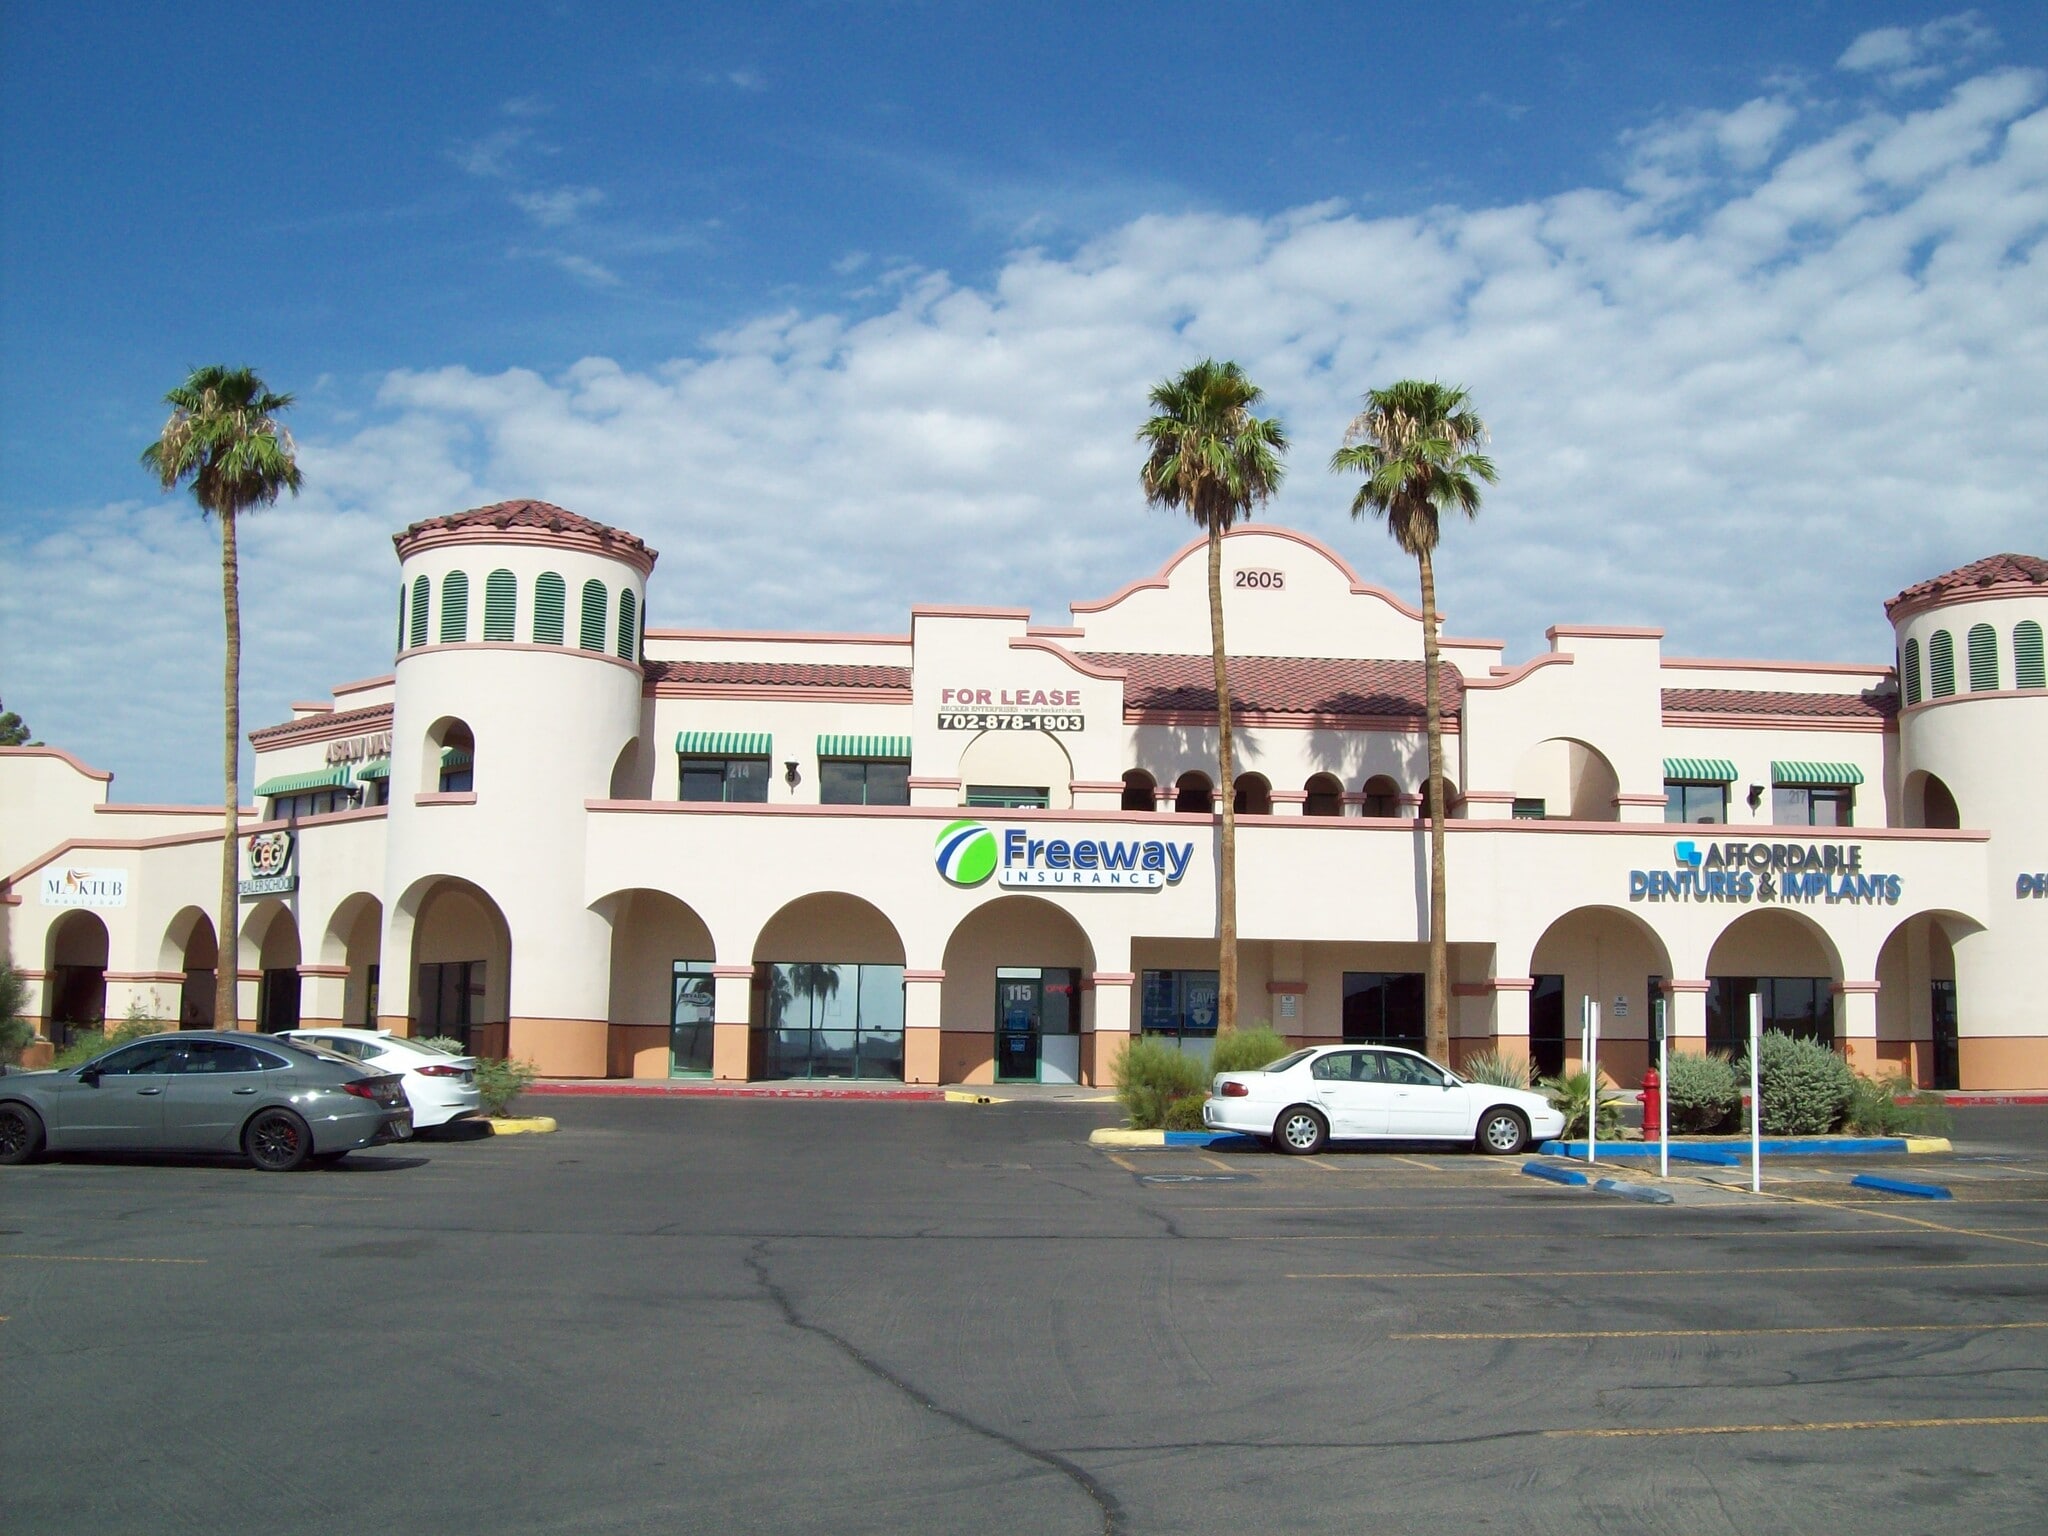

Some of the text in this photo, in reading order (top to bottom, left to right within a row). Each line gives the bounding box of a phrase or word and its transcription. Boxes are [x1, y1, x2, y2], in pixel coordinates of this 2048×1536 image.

[1235, 570, 1284, 589] 2605
[941, 688, 1081, 706] FOR LEASE
[970, 705, 1019, 713] ENTERPRISES
[940, 715, 1082, 730] 702-878-1903
[325, 738, 366, 762] ASIAN
[729, 763, 749, 778] 214
[1788, 789, 1806, 804] 217
[1004, 828, 1195, 882] Freeway
[1704, 842, 1863, 870] AFFORDABLE
[264, 876, 293, 892] SCHOOL
[1005, 871, 1156, 885] INSURANCE
[1630, 870, 1902, 899] DENTURES & IMPLANTS
[2016, 873, 2048, 899] DE
[1008, 984, 1032, 1001] 115
[1190, 991, 1216, 1004] SAVE
